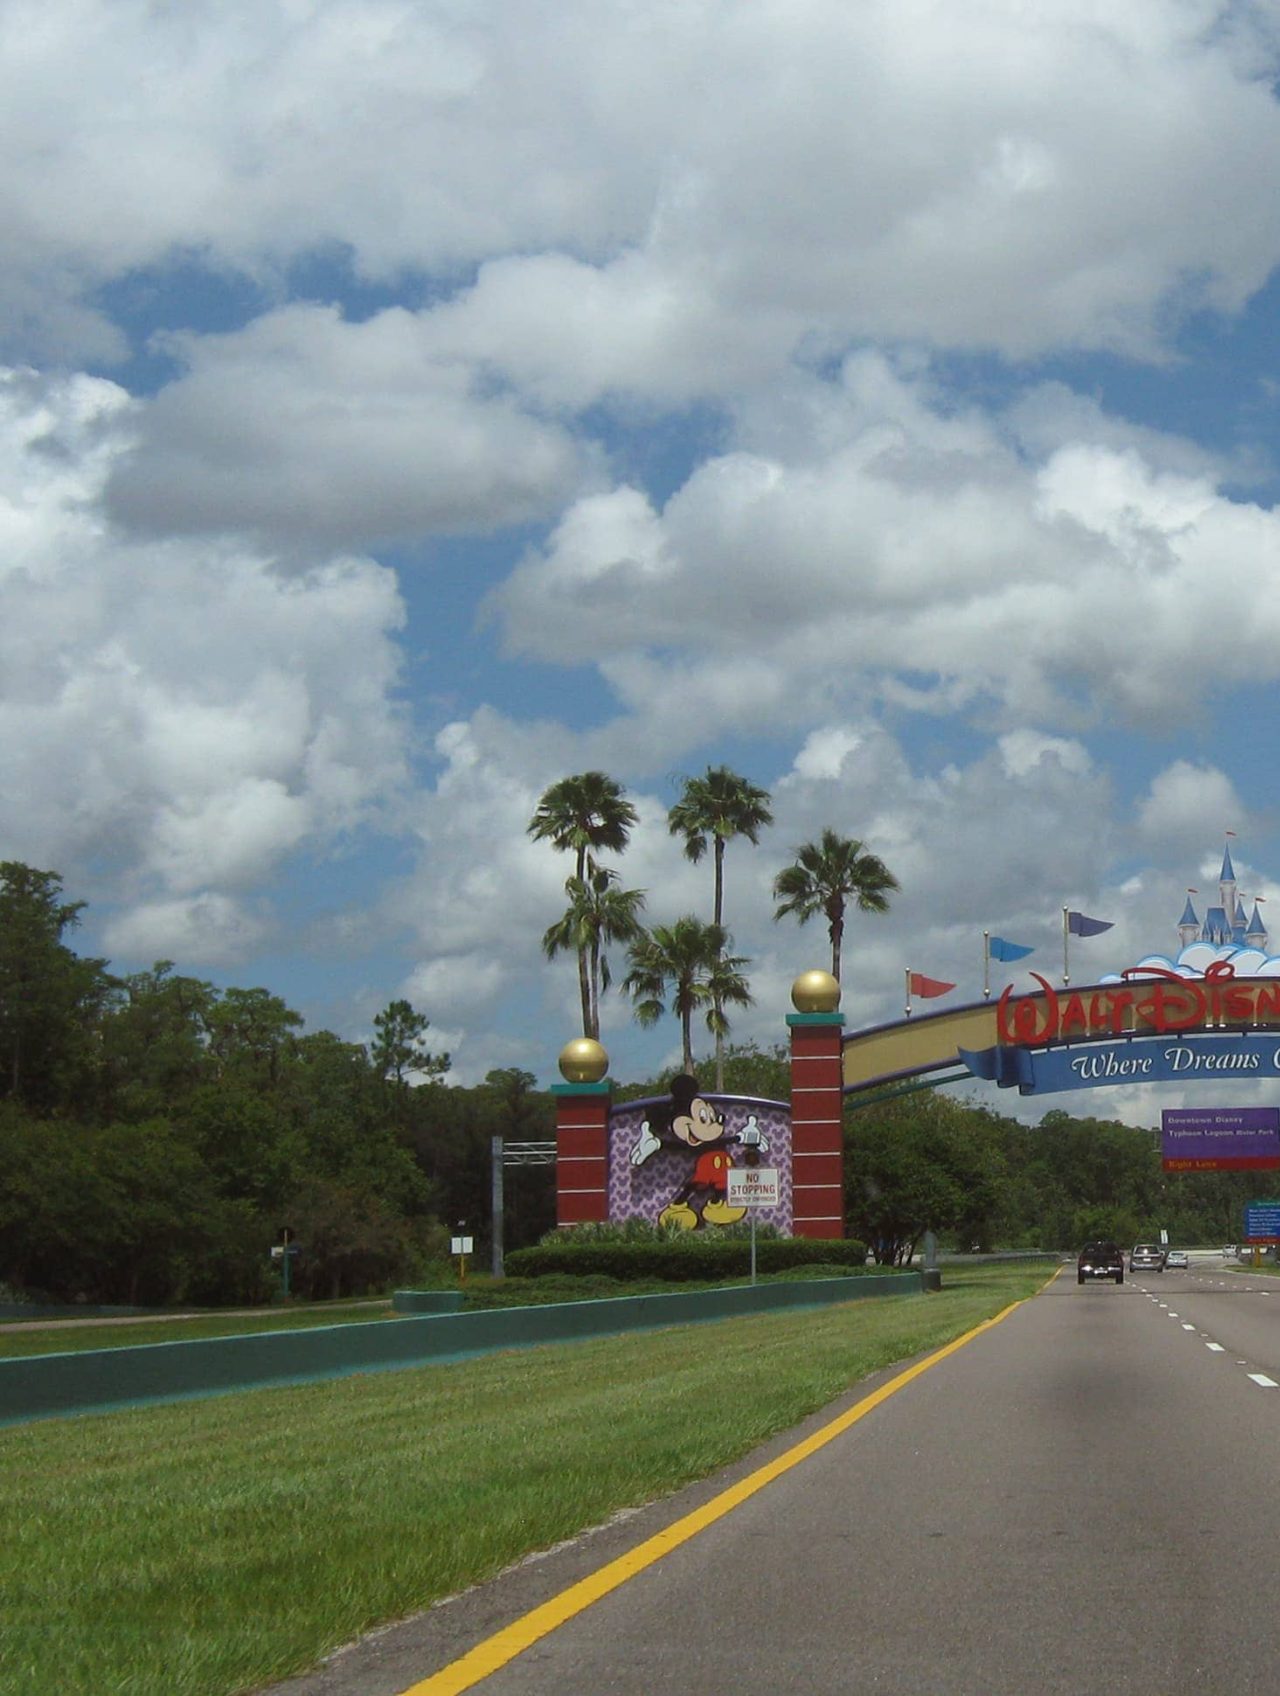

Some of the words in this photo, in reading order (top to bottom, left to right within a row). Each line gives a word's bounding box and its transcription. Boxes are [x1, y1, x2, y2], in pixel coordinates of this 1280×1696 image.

[1071, 1051, 1153, 1080] Where
[1164, 1046, 1260, 1071] Dreams
[1215, 1116, 1244, 1124] Disney
[745, 1173, 759, 1183] NO
[730, 1184, 776, 1195] STOPPING
